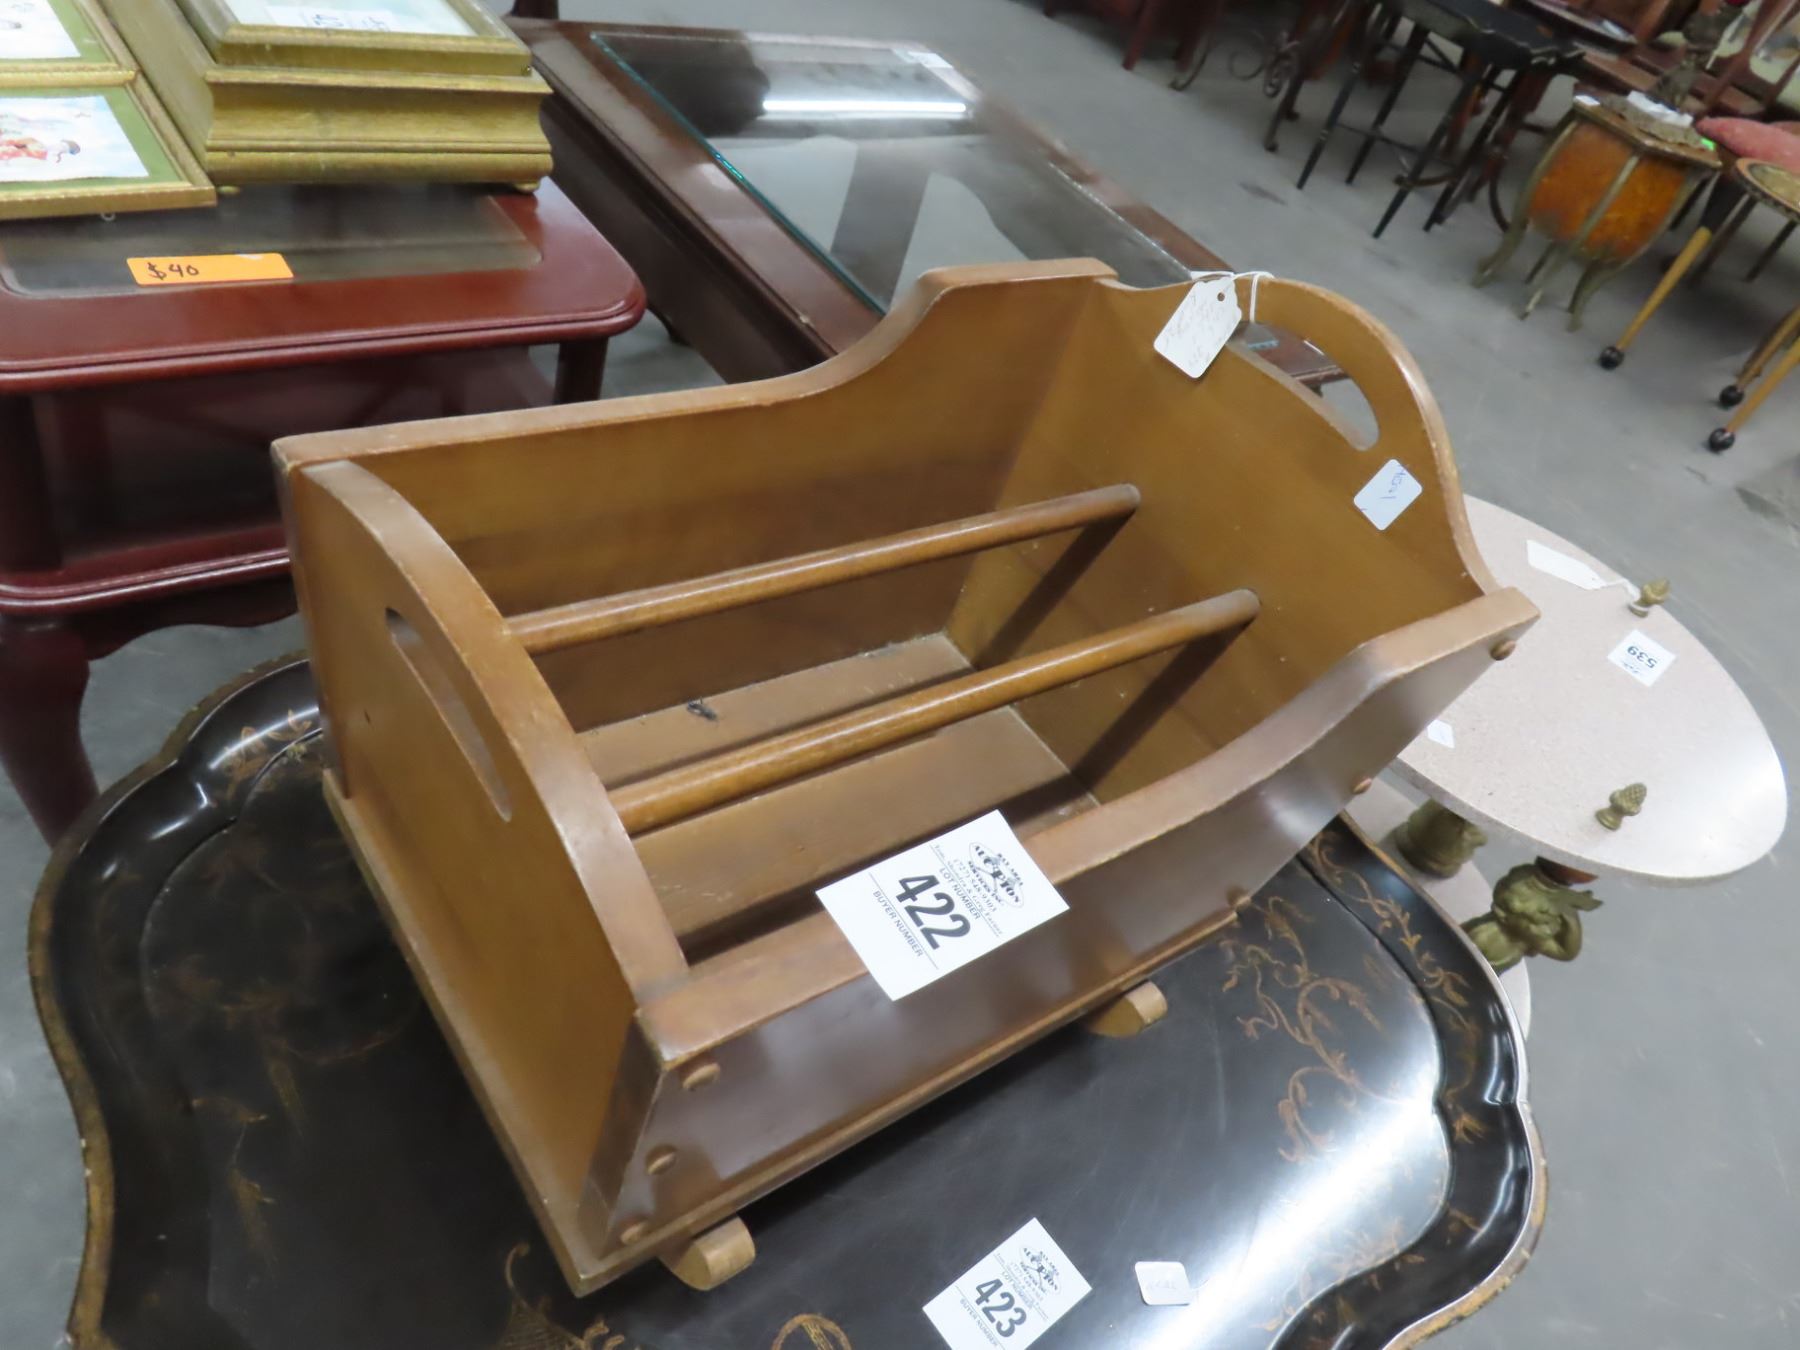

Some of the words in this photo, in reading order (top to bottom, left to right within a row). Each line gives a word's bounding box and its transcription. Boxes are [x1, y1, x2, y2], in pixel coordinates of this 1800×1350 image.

[147, 262, 199, 280] $40
[1627, 645, 1657, 669] 539
[938, 866, 954, 883] LOT
[950, 883, 981, 920] NUMBER
[973, 844, 1020, 904] AUCTION
[872, 890, 898, 920] BUYER
[892, 918, 924, 957] NUMBER
[895, 874, 971, 950] 422
[1001, 1270, 1012, 1283] LOT
[974, 1278, 1028, 1338] 423
